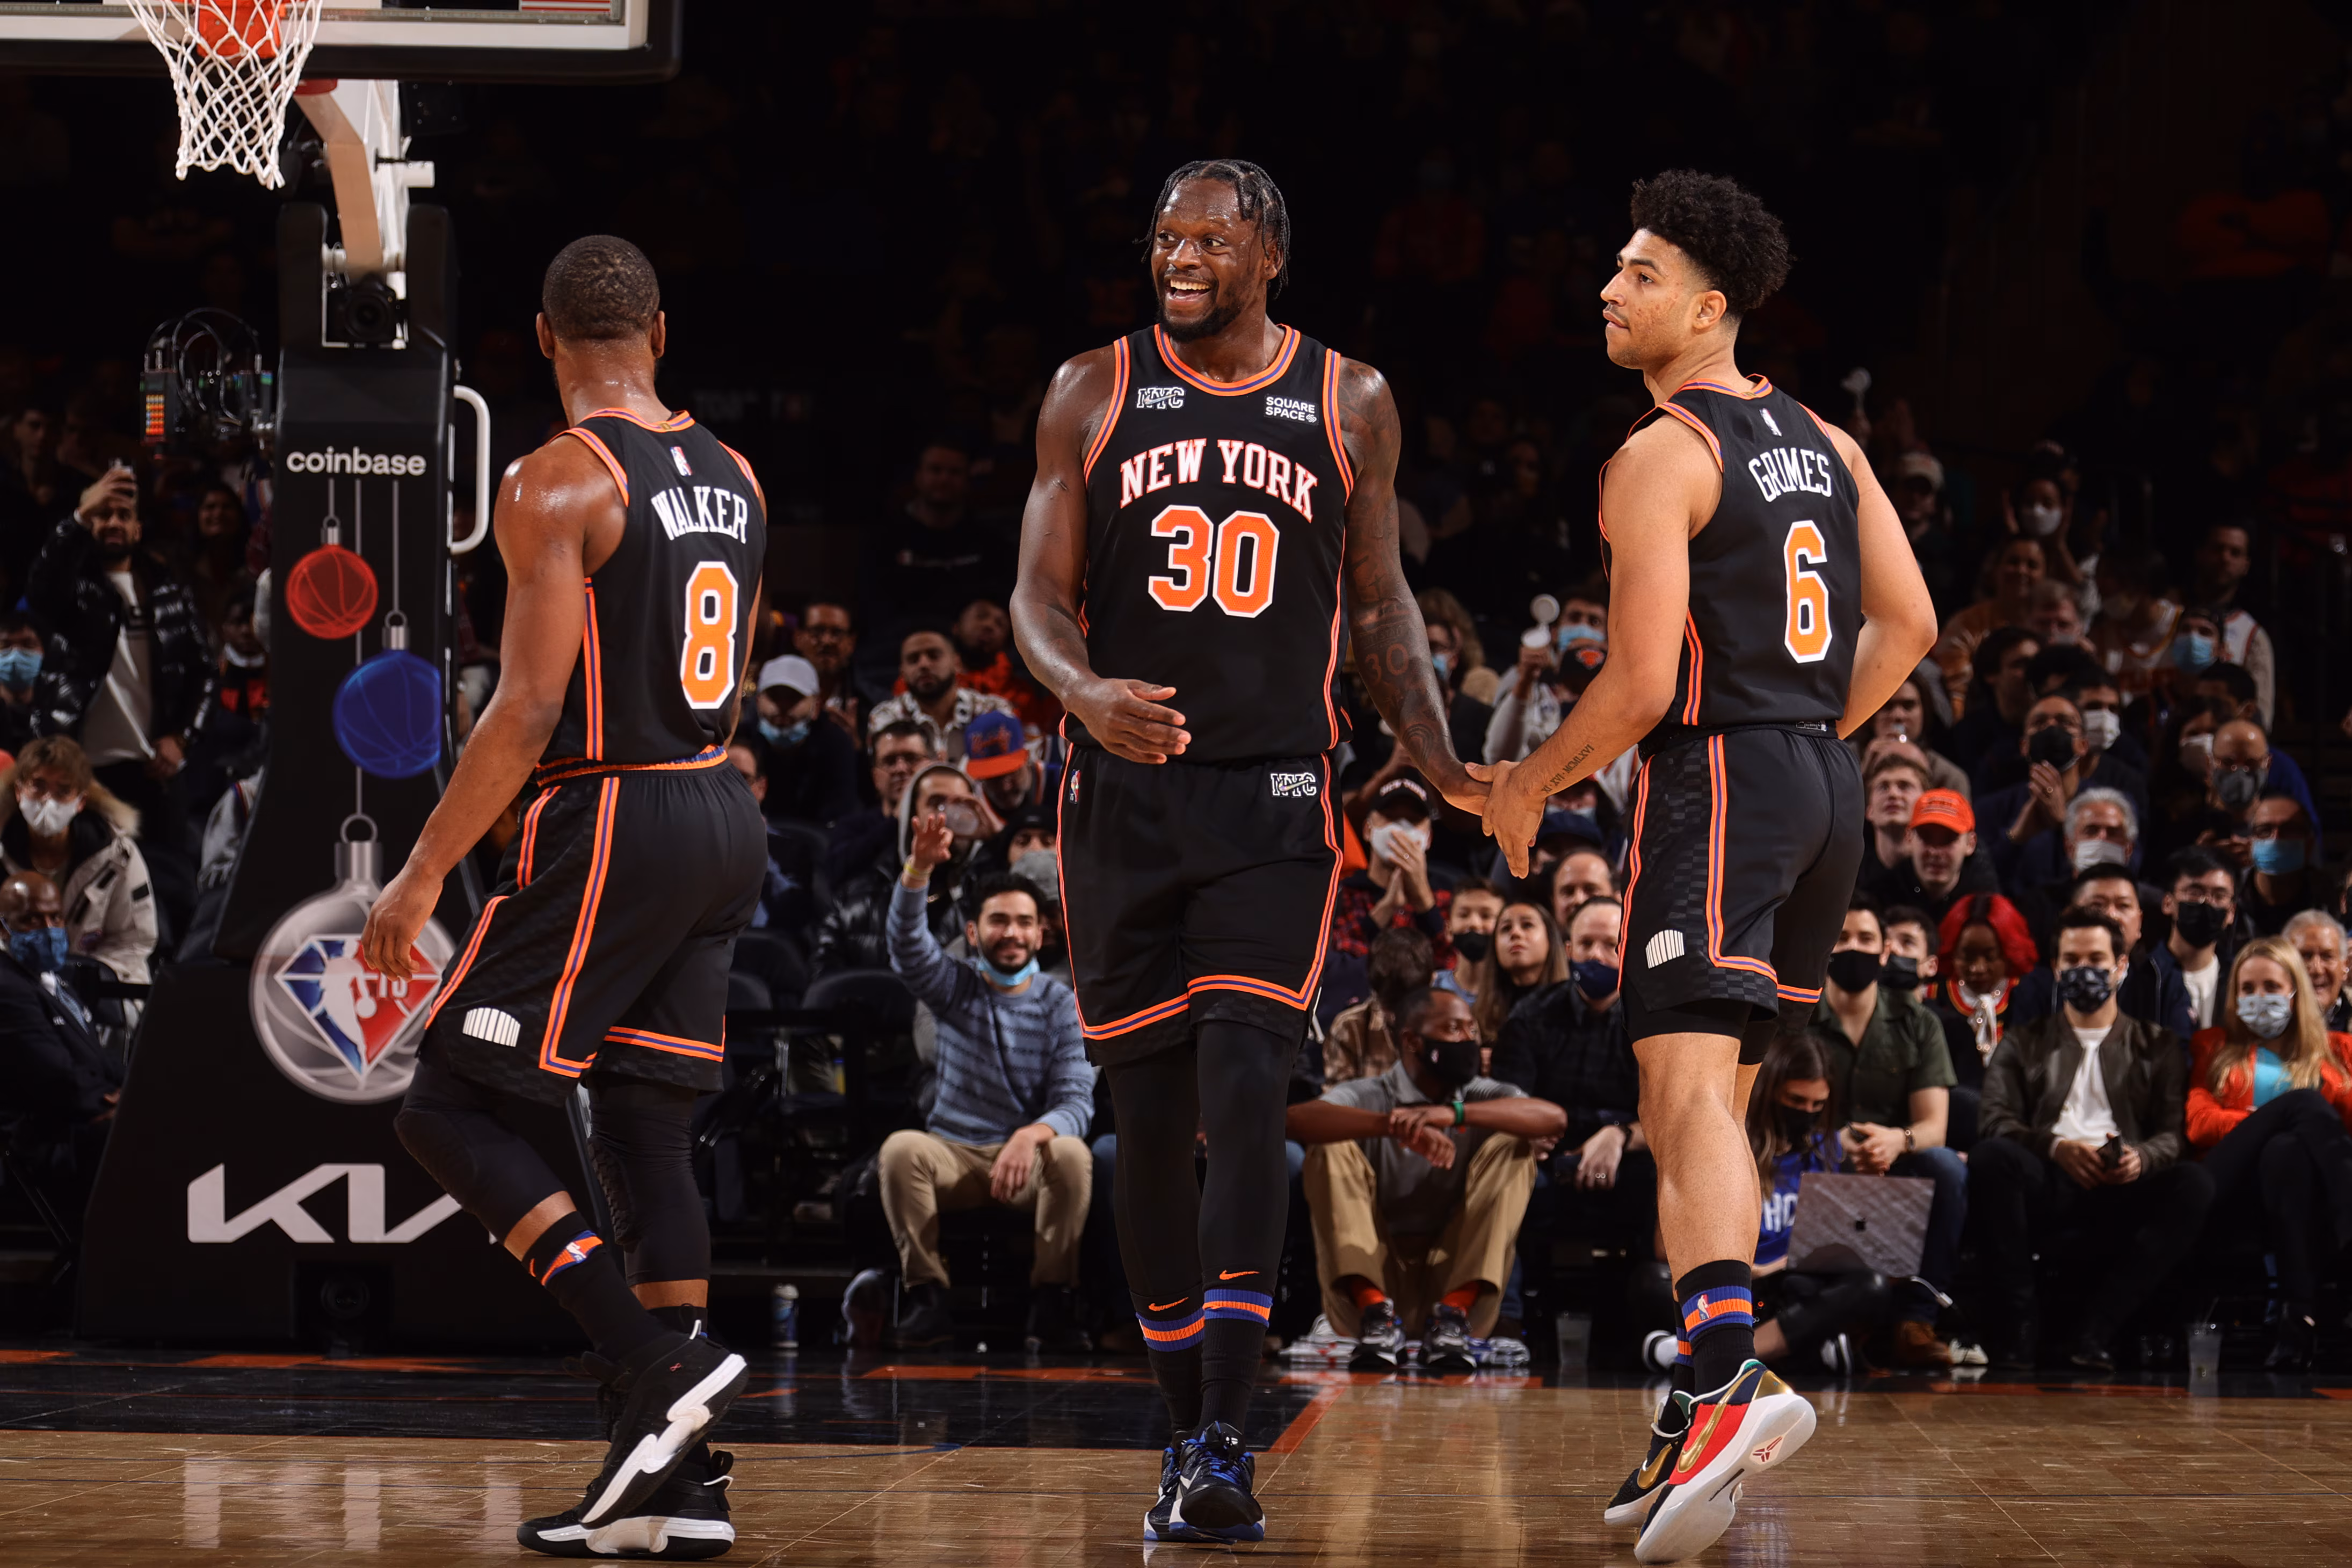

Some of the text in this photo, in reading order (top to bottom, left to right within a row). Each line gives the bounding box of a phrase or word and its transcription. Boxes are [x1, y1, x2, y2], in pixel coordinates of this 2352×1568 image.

[1136, 387, 1185, 409] NYC
[1265, 406, 1305, 421] SPACE
[1266, 396, 1315, 413] SQUARE
[286, 446, 426, 476] coinbase
[1120, 438, 1317, 523] NEW YORK
[1748, 447, 1832, 502] GRIMES
[651, 486, 748, 544] WALKER
[1148, 505, 1280, 619] 30
[1784, 520, 1832, 664] 6
[680, 561, 738, 709] 8
[1271, 772, 1317, 796] NYC
